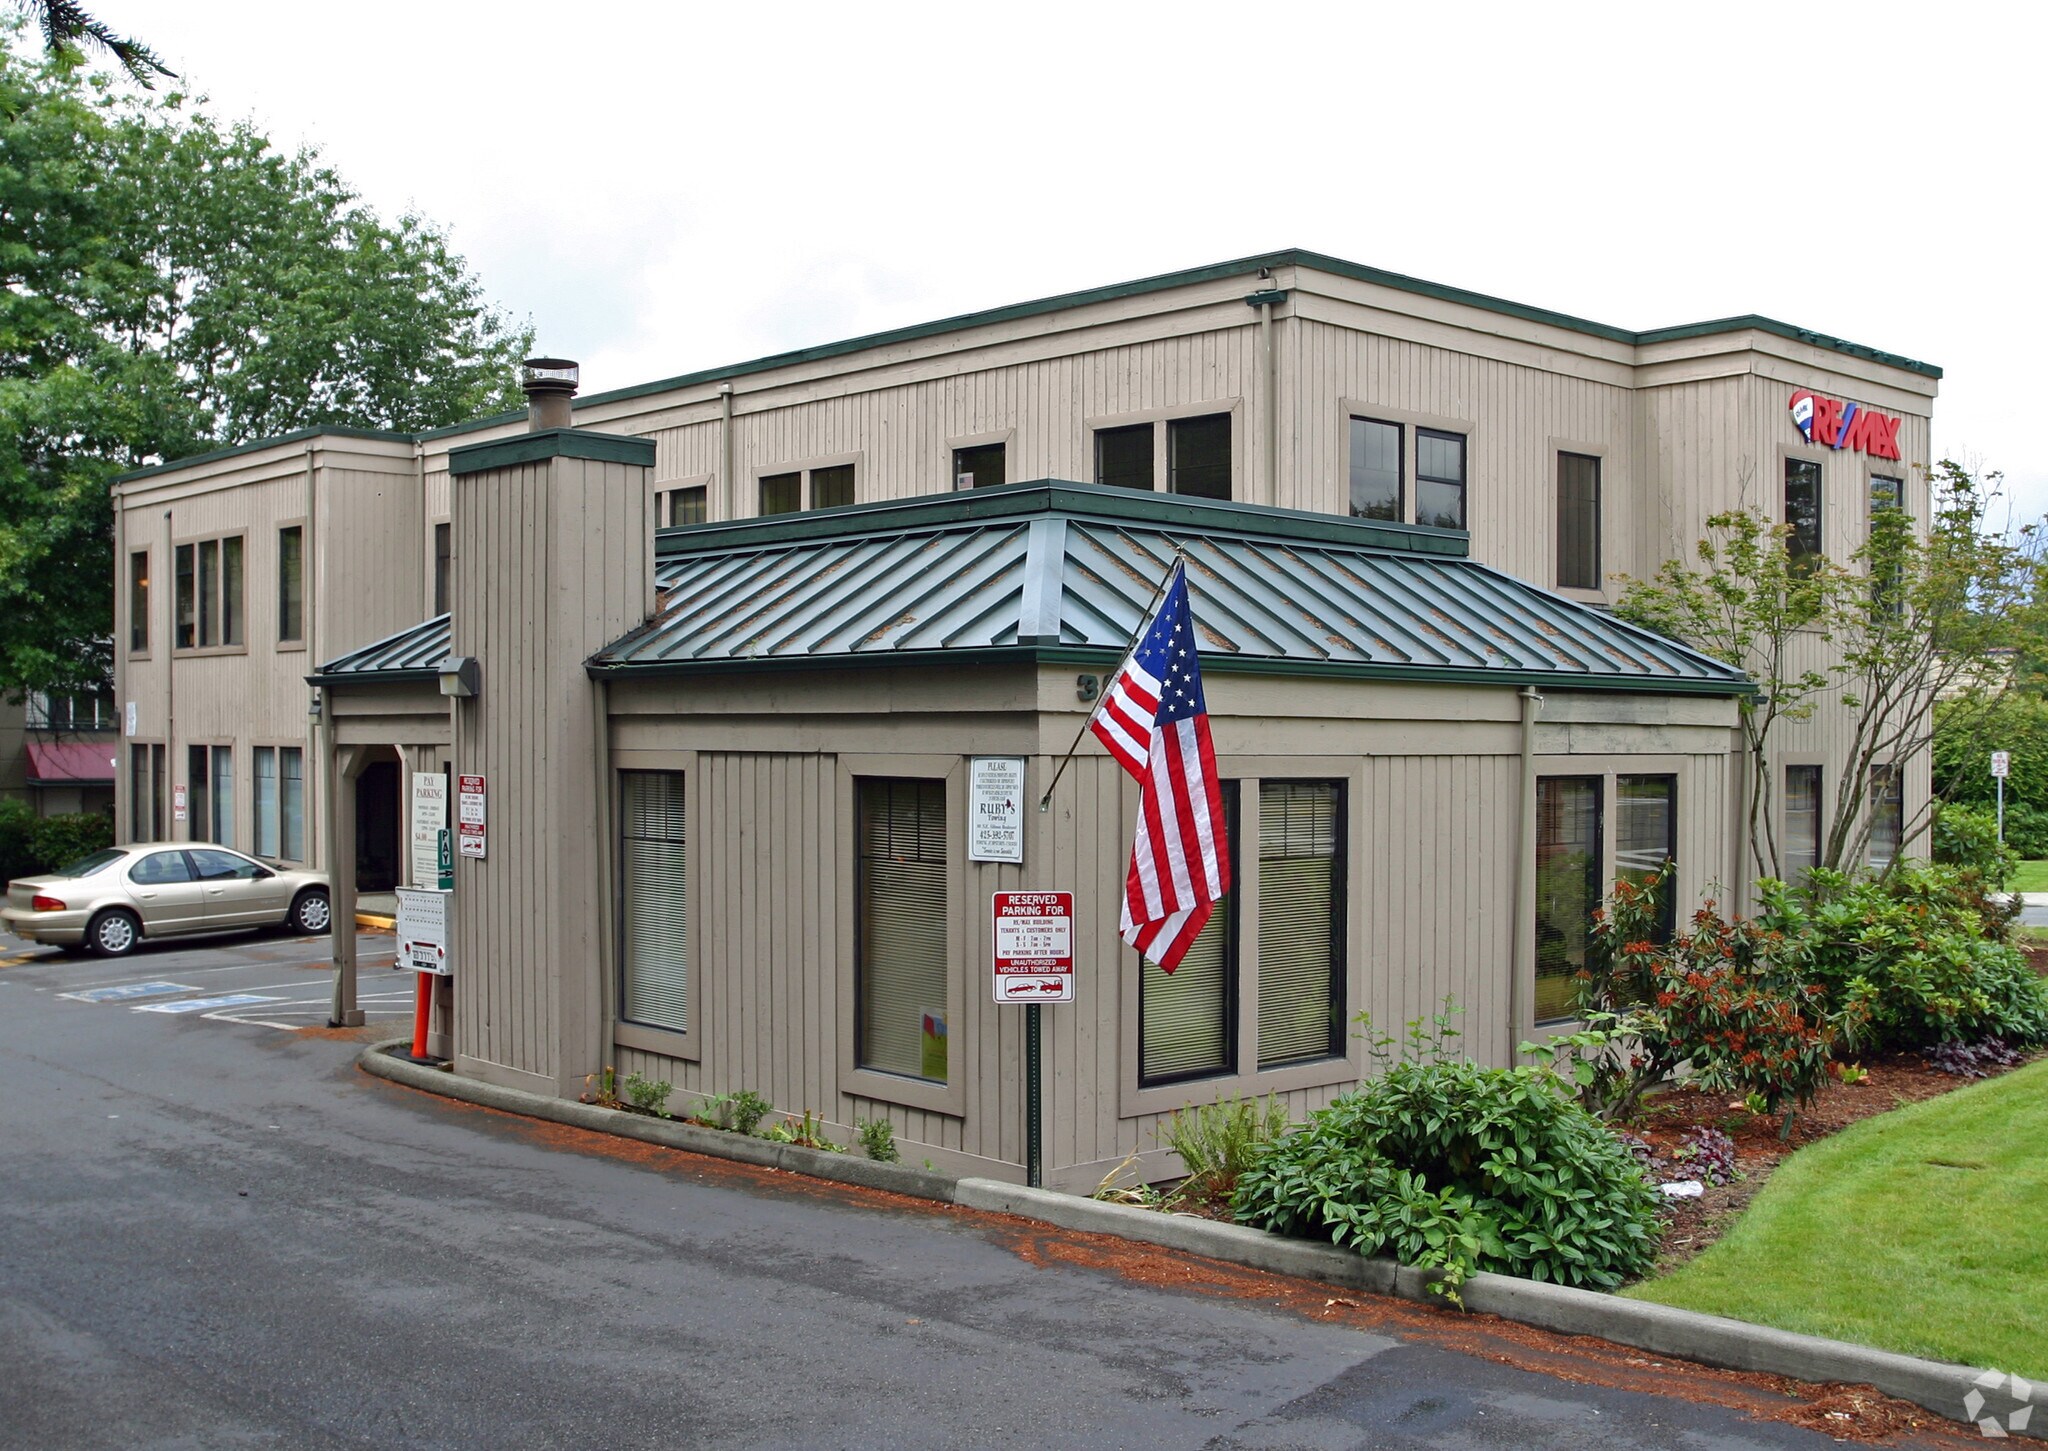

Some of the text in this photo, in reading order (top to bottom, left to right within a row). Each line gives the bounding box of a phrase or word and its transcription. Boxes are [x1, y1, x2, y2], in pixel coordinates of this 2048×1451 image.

[1812, 394, 1902, 461] RE/MAX
[987, 762, 1007, 771] PLEASE
[423, 776, 435, 787] PAY
[416, 788, 442, 799] PARKING
[988, 814, 1007, 824] Towing
[442, 831, 450, 865] PAY
[1008, 895, 1058, 904] RESERVED
[1002, 906, 1064, 915] PARKING FOR
